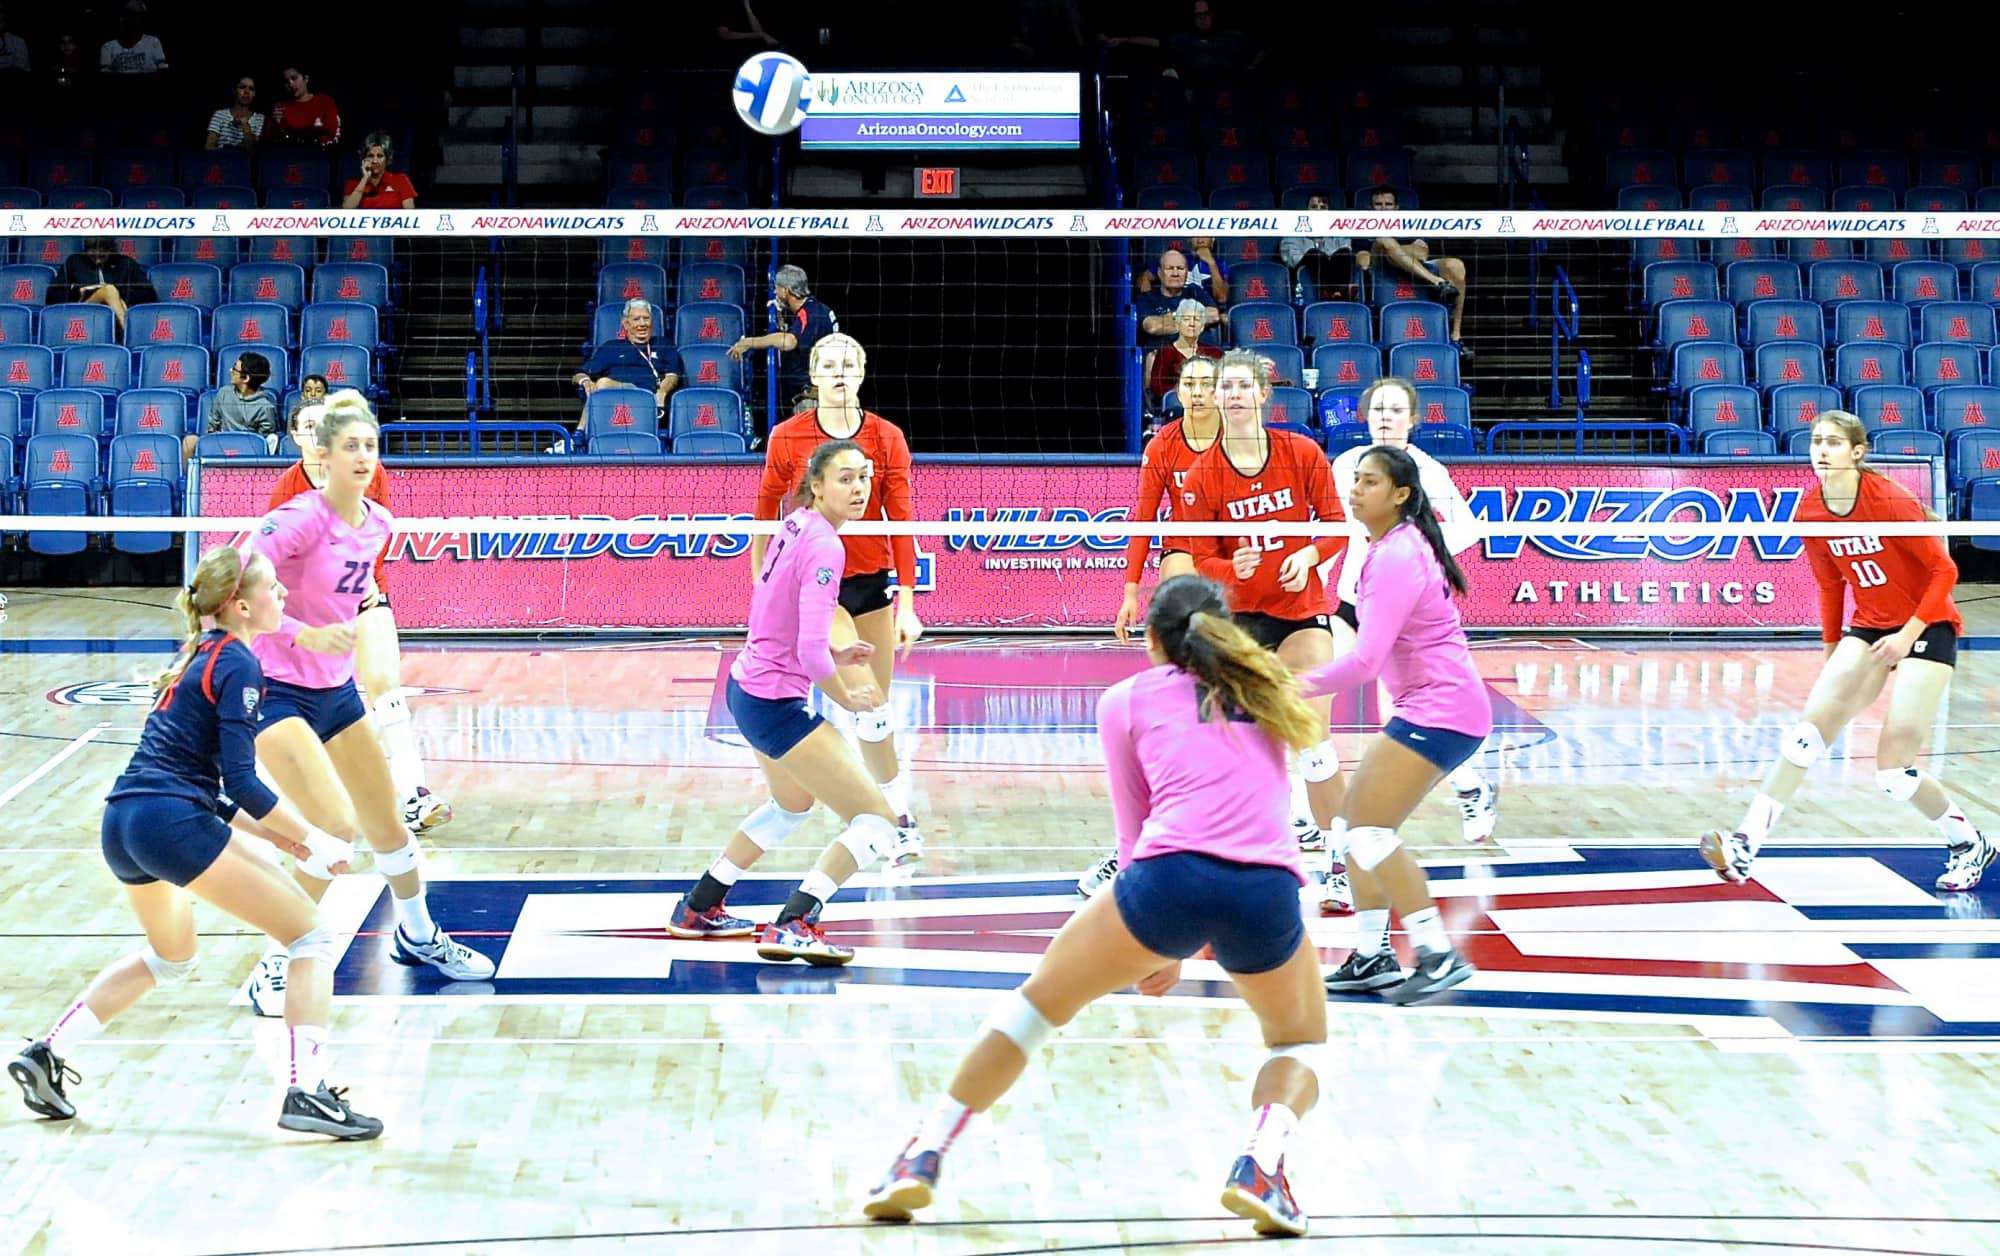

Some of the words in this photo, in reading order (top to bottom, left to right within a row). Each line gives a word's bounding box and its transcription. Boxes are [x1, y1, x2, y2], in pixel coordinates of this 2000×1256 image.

[843, 93, 922, 105] ONCOLOGY
[844, 79, 925, 95] ARIZONA
[856, 122, 1023, 138] ArizonaOncology.com
[920, 168, 955, 196] EXIT
[1226, 488, 1295, 520] UTAH
[1467, 486, 1806, 560] ARIZON
[382, 514, 756, 560] NAWILDCATS
[1826, 534, 1886, 558] UTAH
[985, 557, 1063, 570] INVESTING
[1066, 557, 1082, 569] IN
[1085, 557, 1148, 569] ARIZO
[1850, 559, 1889, 589] 10
[334, 560, 371, 594] 22
[1515, 581, 1776, 603] ATHLETICS
